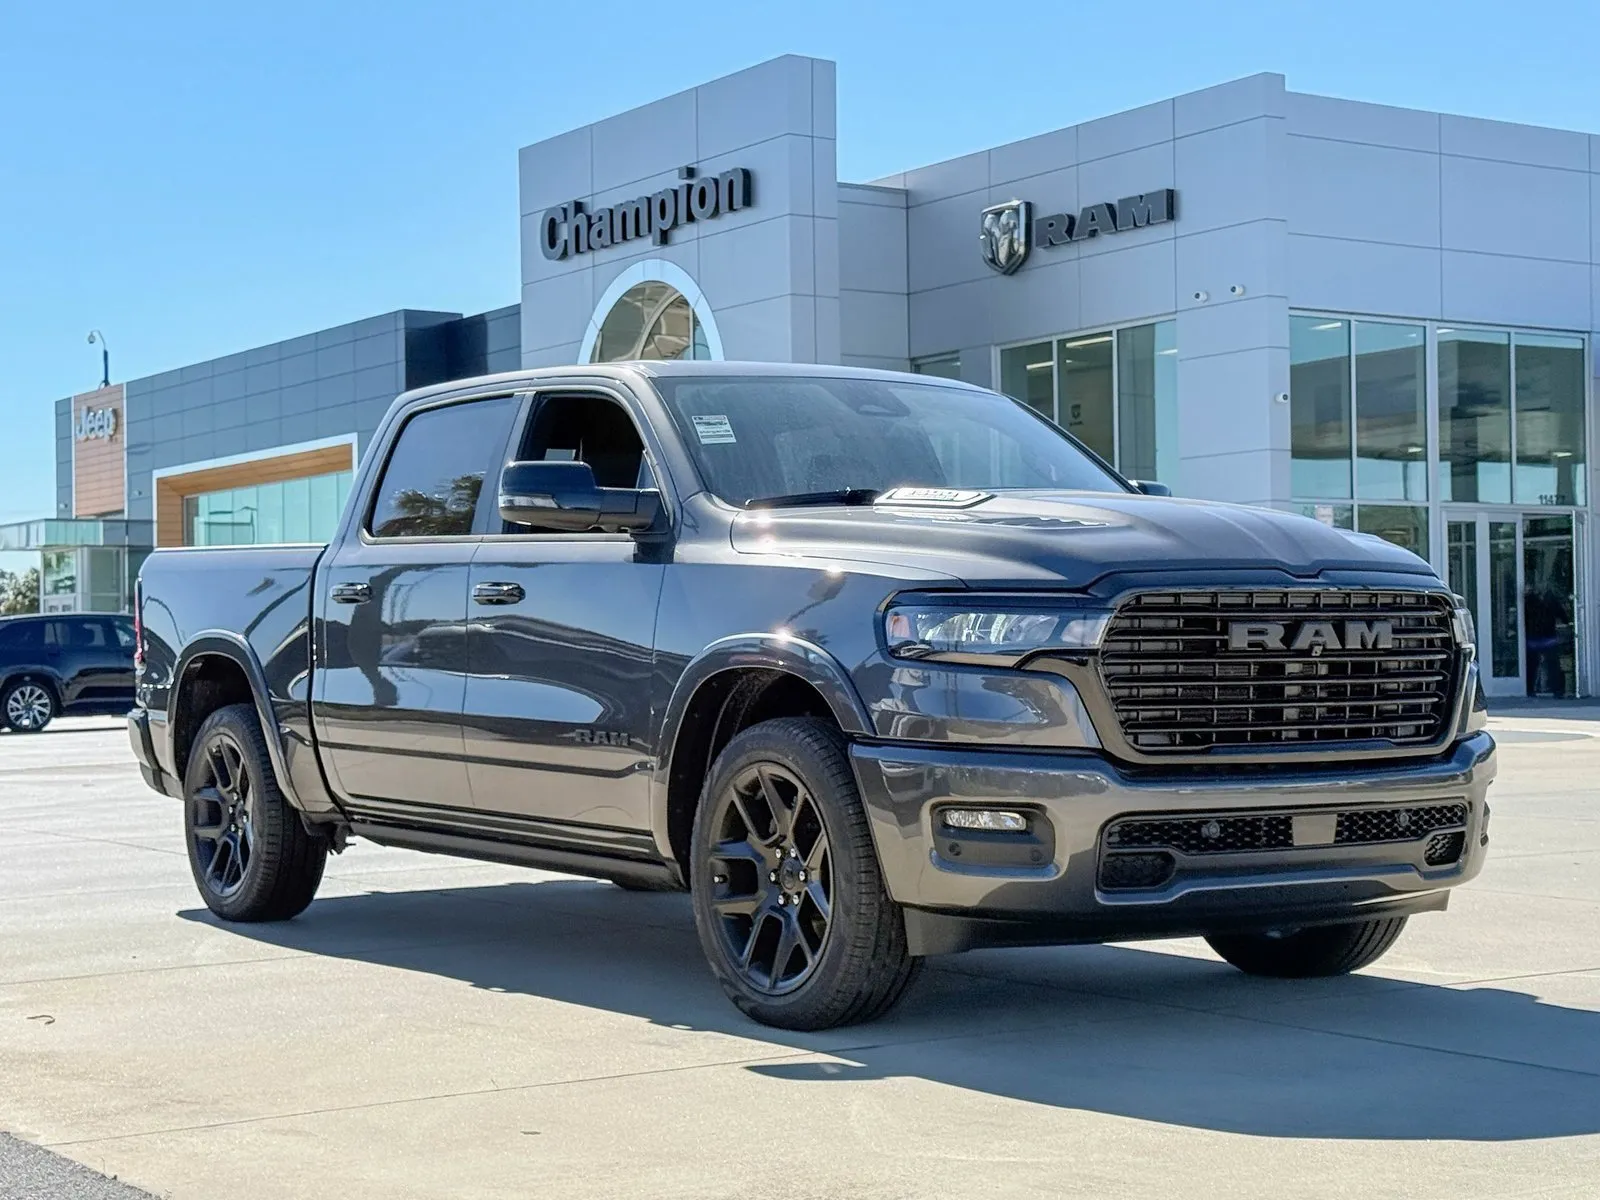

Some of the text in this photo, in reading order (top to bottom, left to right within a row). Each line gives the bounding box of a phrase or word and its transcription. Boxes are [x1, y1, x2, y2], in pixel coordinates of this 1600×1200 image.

[540, 166, 752, 260] Champion
[1035, 188, 1175, 249] RAM
[76, 406, 117, 443] Jeep
[1228, 620, 1393, 651] RAM
[575, 728, 631, 746] RAM
